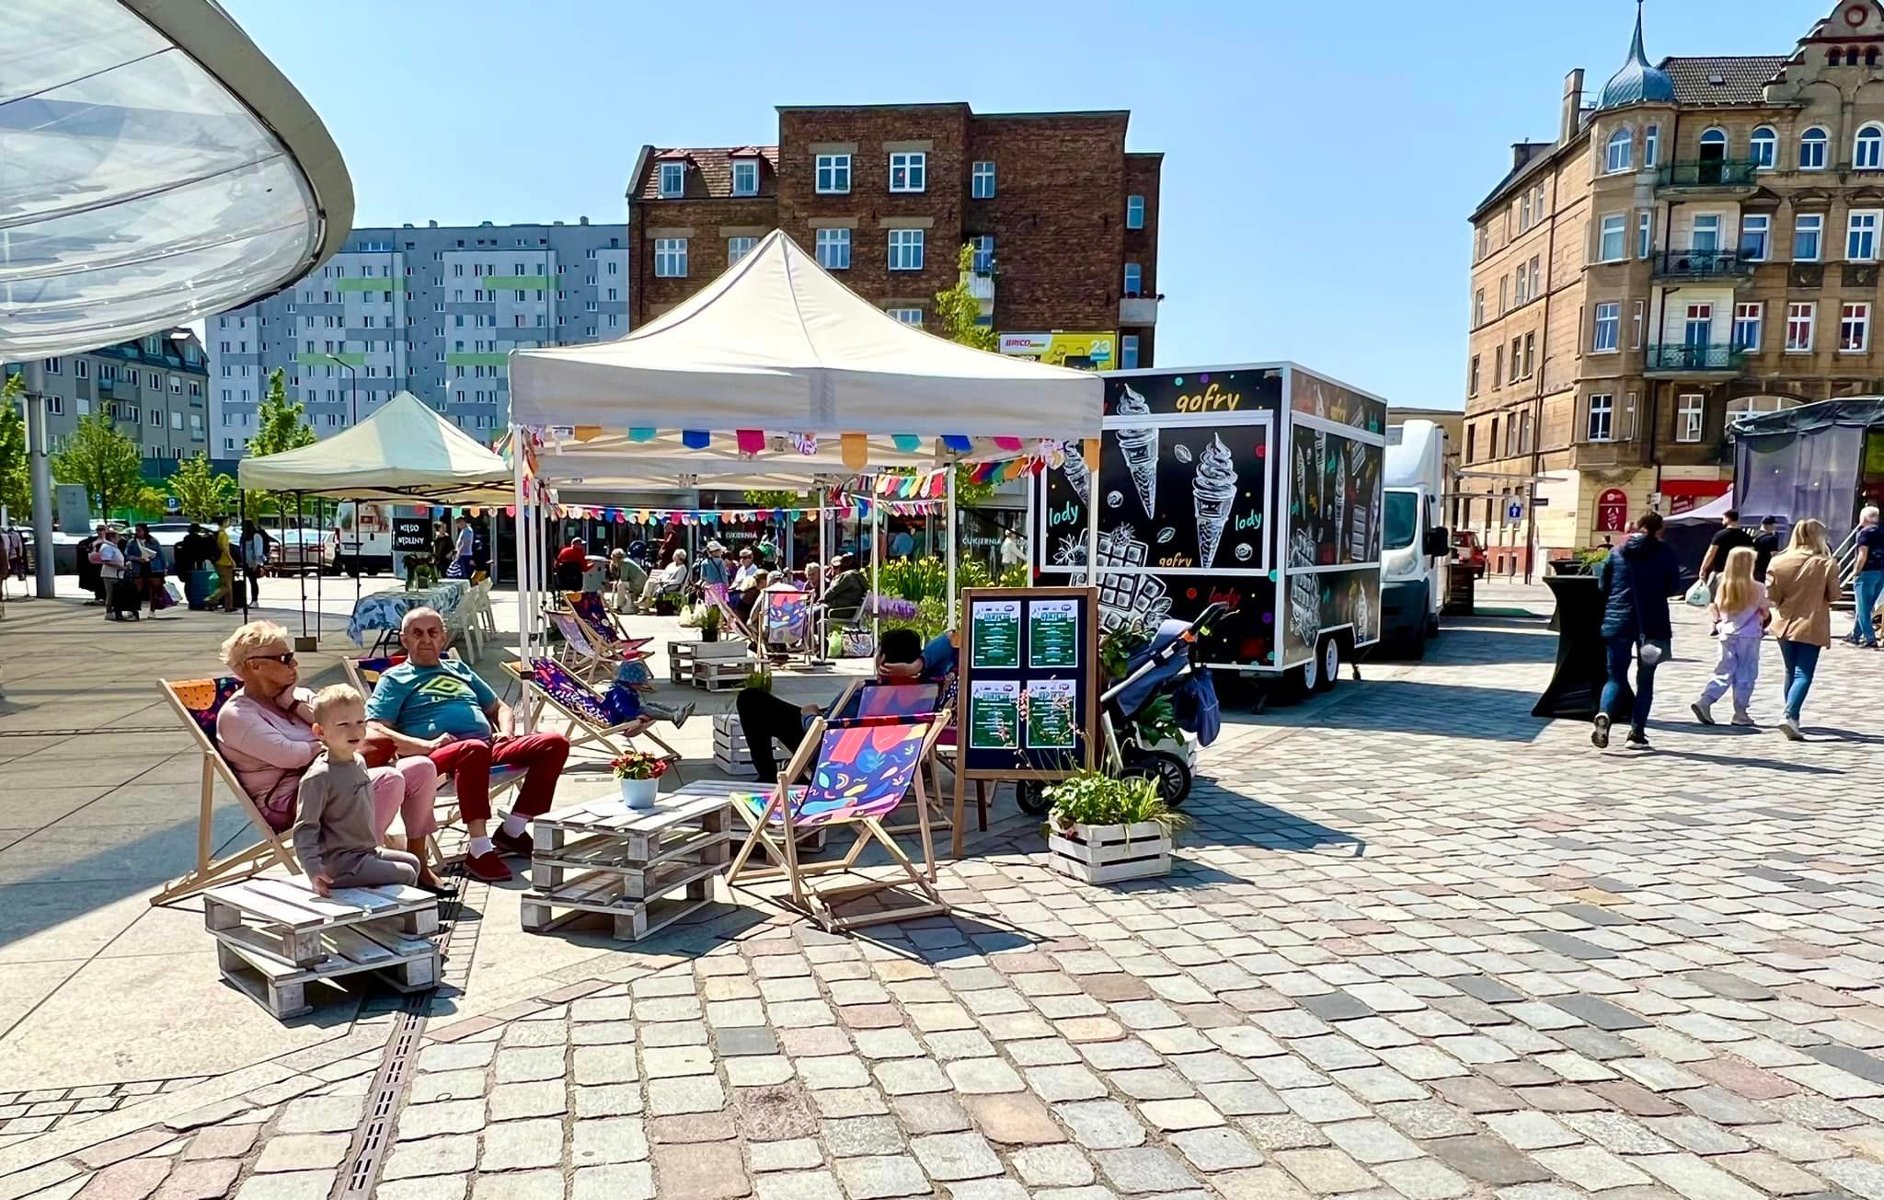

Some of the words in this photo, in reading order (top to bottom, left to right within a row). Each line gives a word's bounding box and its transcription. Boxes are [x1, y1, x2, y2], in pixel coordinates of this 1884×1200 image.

[1176, 383, 1240, 413] gofry
[1049, 500, 1078, 528] lody
[1235, 509, 1262, 531] lody
[1159, 552, 1193, 568] gofry
